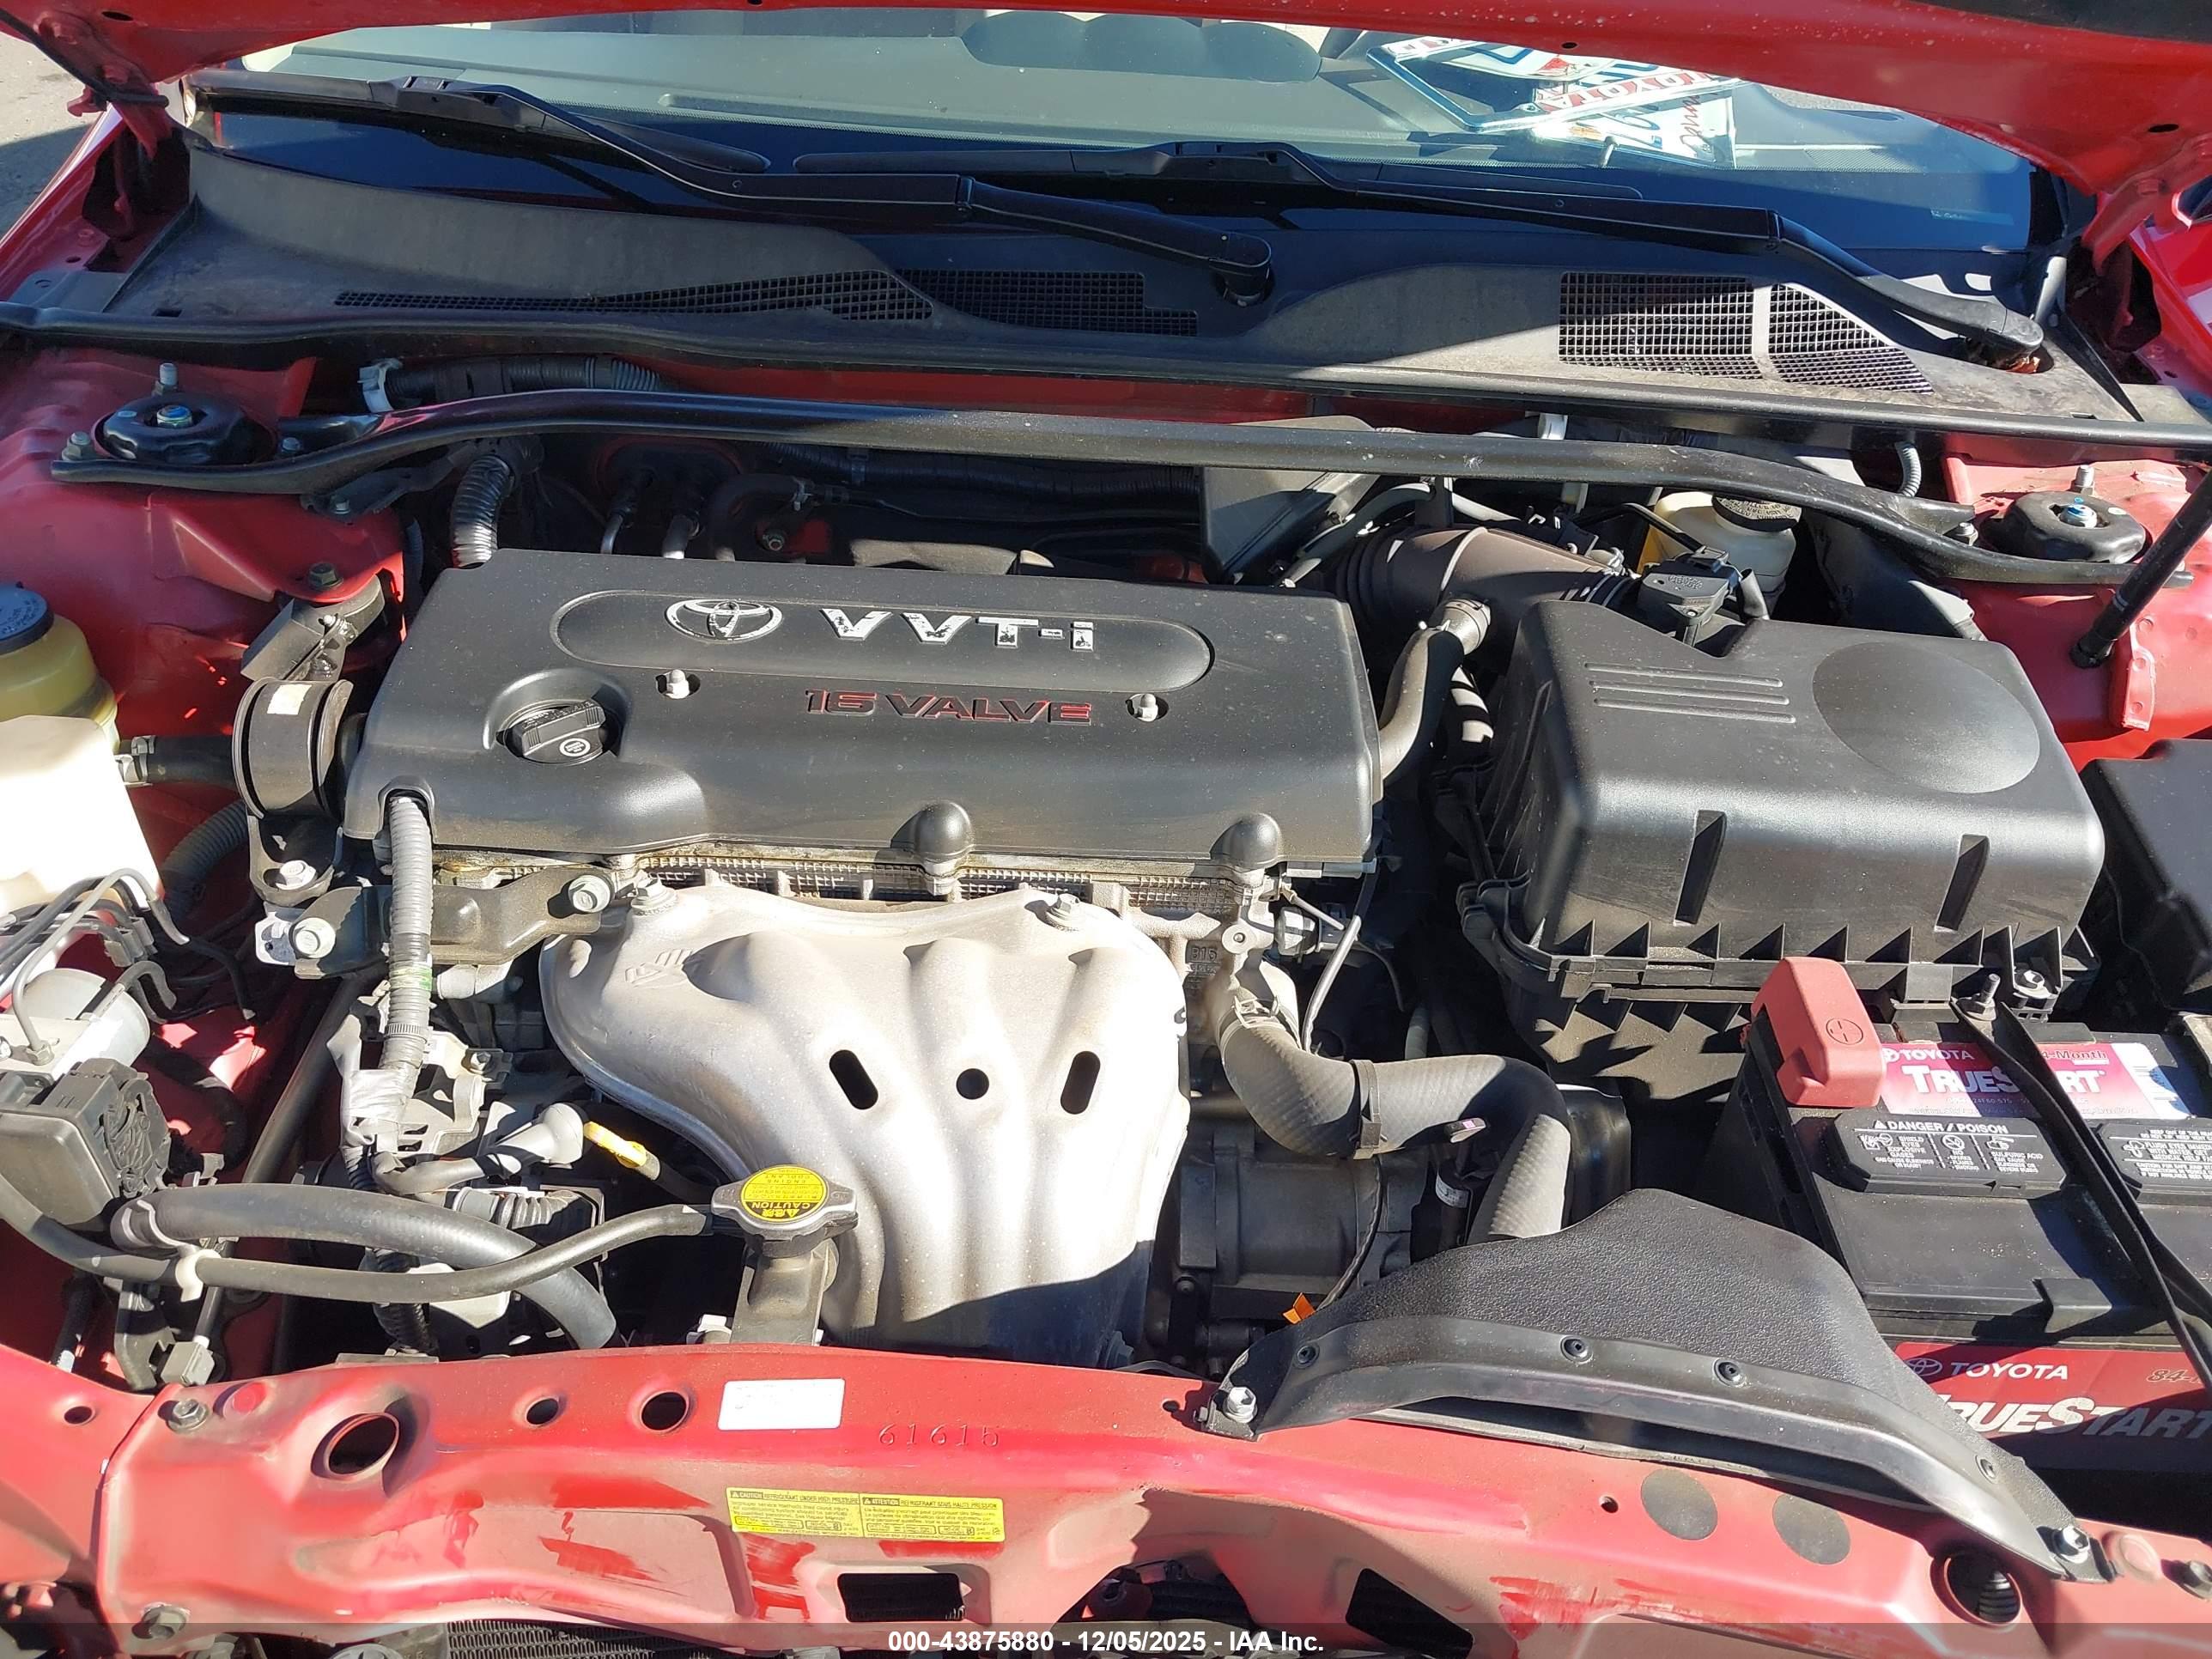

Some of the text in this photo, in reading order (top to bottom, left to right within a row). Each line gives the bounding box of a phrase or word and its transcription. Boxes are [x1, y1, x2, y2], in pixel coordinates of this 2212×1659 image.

[820, 607, 1095, 652] VVT-i
[883, 694, 1093, 725] VALVE
[1899, 1048, 1976, 1060] TOYOTA
[1901, 1066, 2102, 1094] TRUESRT
[1887, 1120, 1944, 1132] DANGER
[1956, 1123, 2009, 1134] POISON
[1950, 1361, 2069, 1381] TOYOTA
